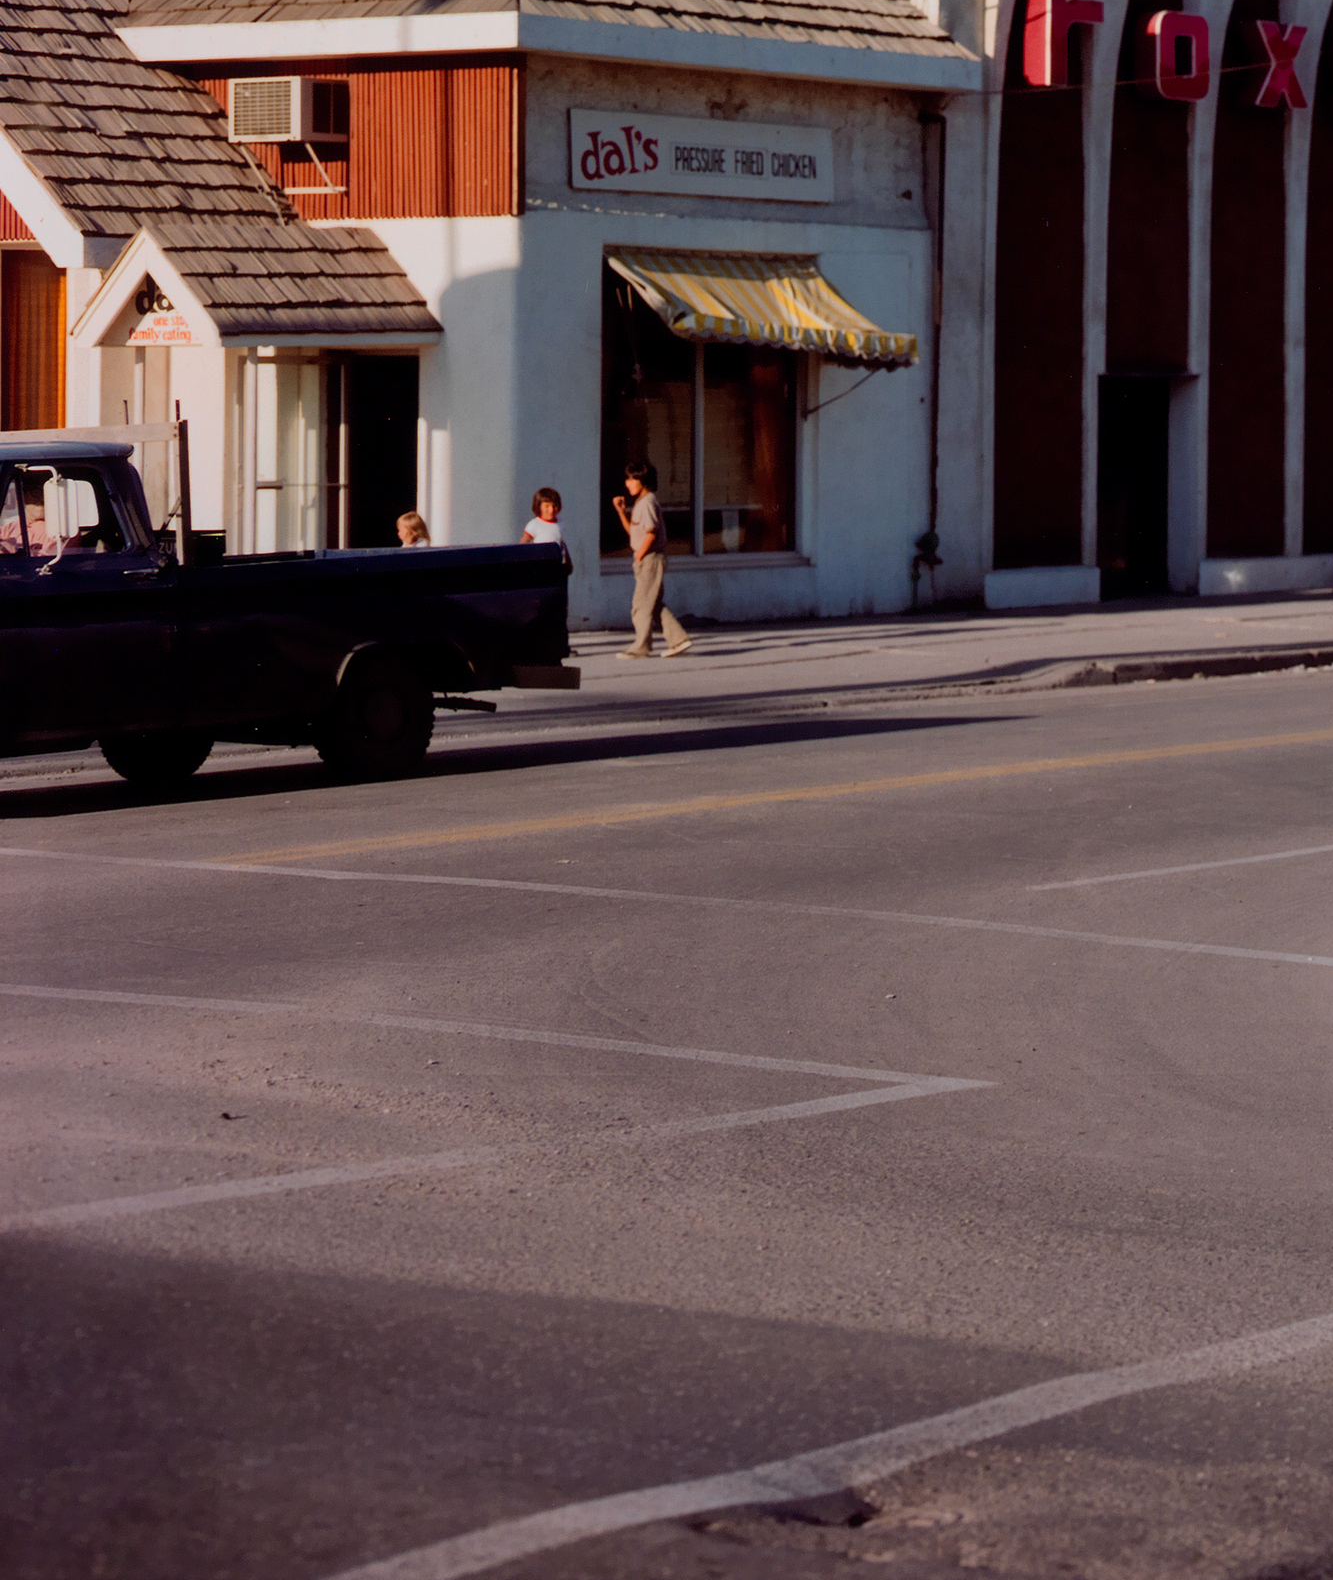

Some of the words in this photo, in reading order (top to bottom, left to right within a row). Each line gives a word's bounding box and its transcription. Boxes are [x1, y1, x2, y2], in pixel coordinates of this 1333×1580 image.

[580, 125, 659, 180] dal's
[674, 145, 726, 174] PRESSURE
[734, 150, 764, 176] FRIED
[771, 152, 817, 179] CHICKEN
[129, 327, 161, 343] family
[162, 327, 192, 344] eating
